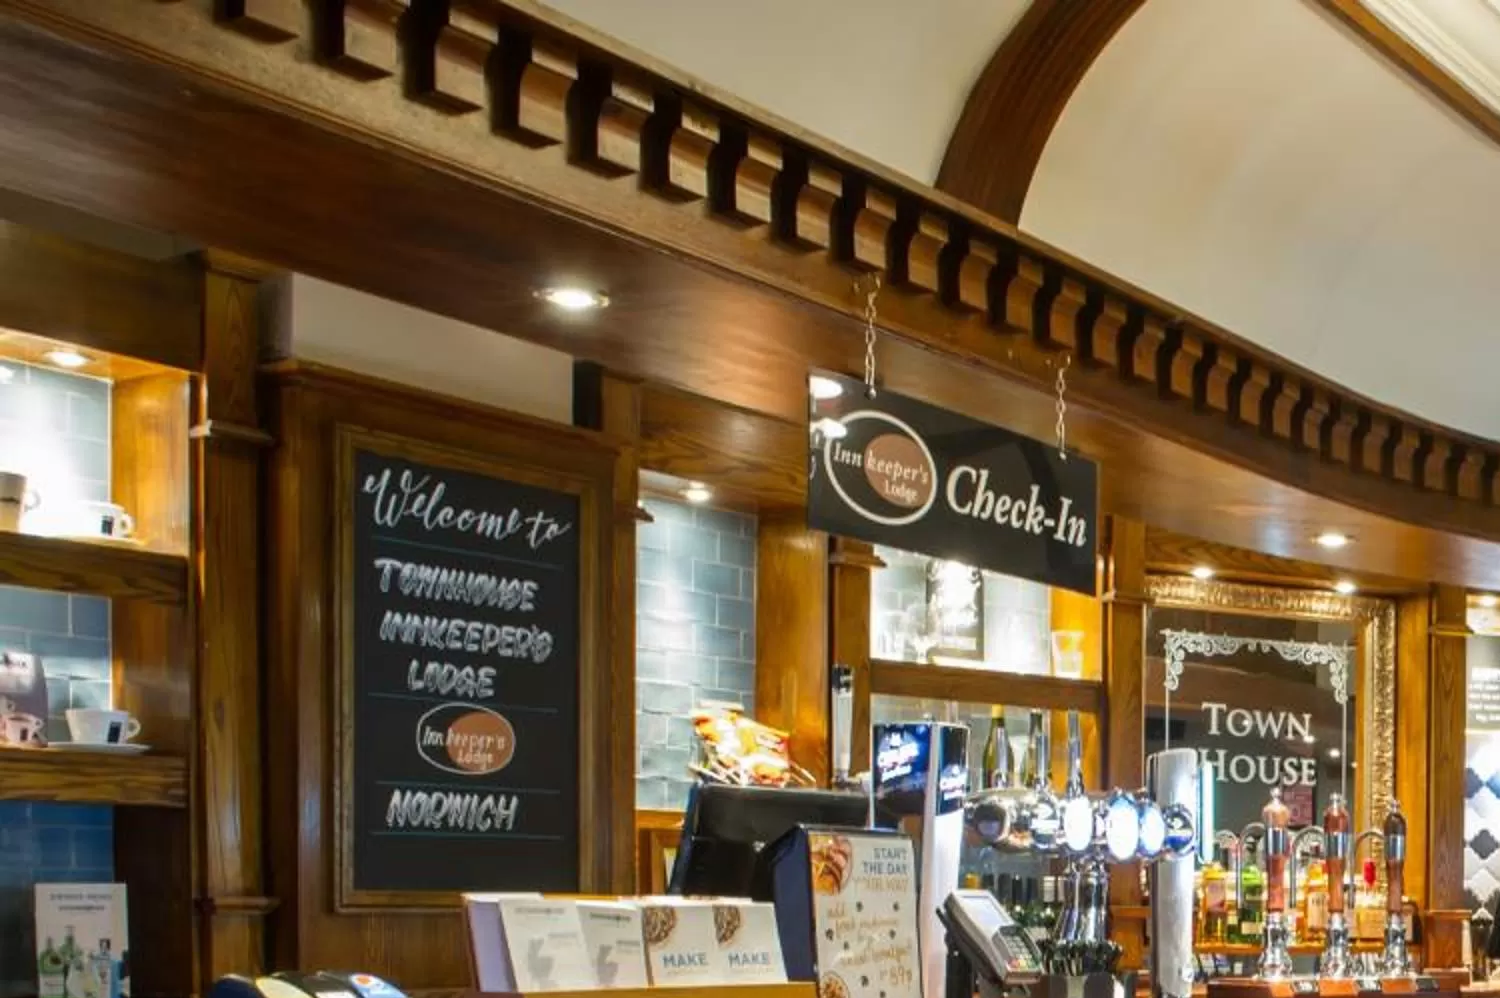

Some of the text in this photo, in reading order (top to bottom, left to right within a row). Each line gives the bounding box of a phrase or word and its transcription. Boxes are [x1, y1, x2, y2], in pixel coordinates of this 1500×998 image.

[833, 443, 929, 485] Inn keeper's
[362, 468, 572, 549] Welcome to
[884, 479, 918, 504] Lodge
[946, 465, 1088, 547] Check-In
[407, 658, 497, 698] LODGE
[1201, 702, 1313, 740] TOWN
[1198, 748, 1317, 786] HOUSE
[386, 789, 518, 831] NORWICH
[663, 952, 708, 969] MAKE
[728, 951, 770, 968] MAKE
